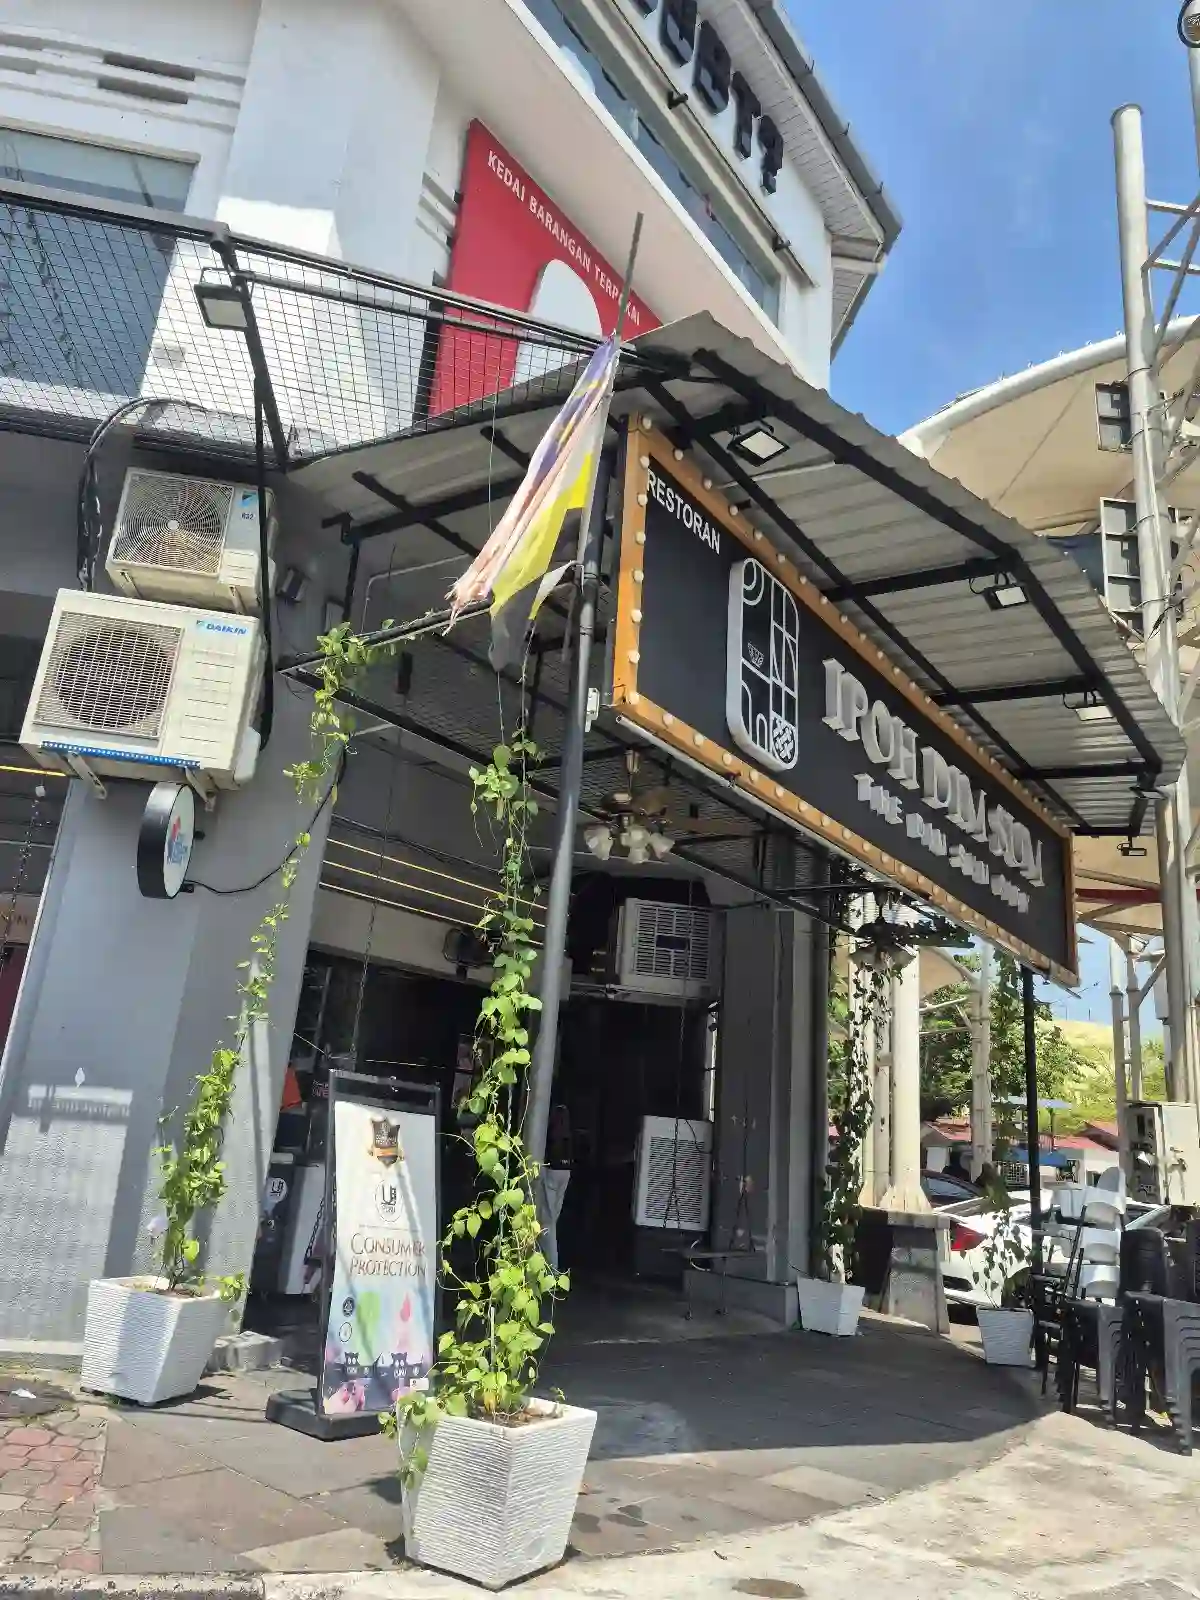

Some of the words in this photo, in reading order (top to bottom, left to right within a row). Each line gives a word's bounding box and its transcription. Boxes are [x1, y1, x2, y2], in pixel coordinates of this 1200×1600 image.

[487, 149, 526, 202] KEDAI
[529, 195, 592, 273] BARANGAN
[594, 263, 641, 327] TERPKAI
[647, 468, 721, 555] RESTORAN
[206, 622, 248, 635] DAIKIN
[821, 657, 920, 791] IPOH
[919, 745, 989, 843] DIM
[853, 772, 904, 825] THE
[349, 1256, 428, 1278] PROTECTION
[350, 1232, 426, 1257] CONSUMER
